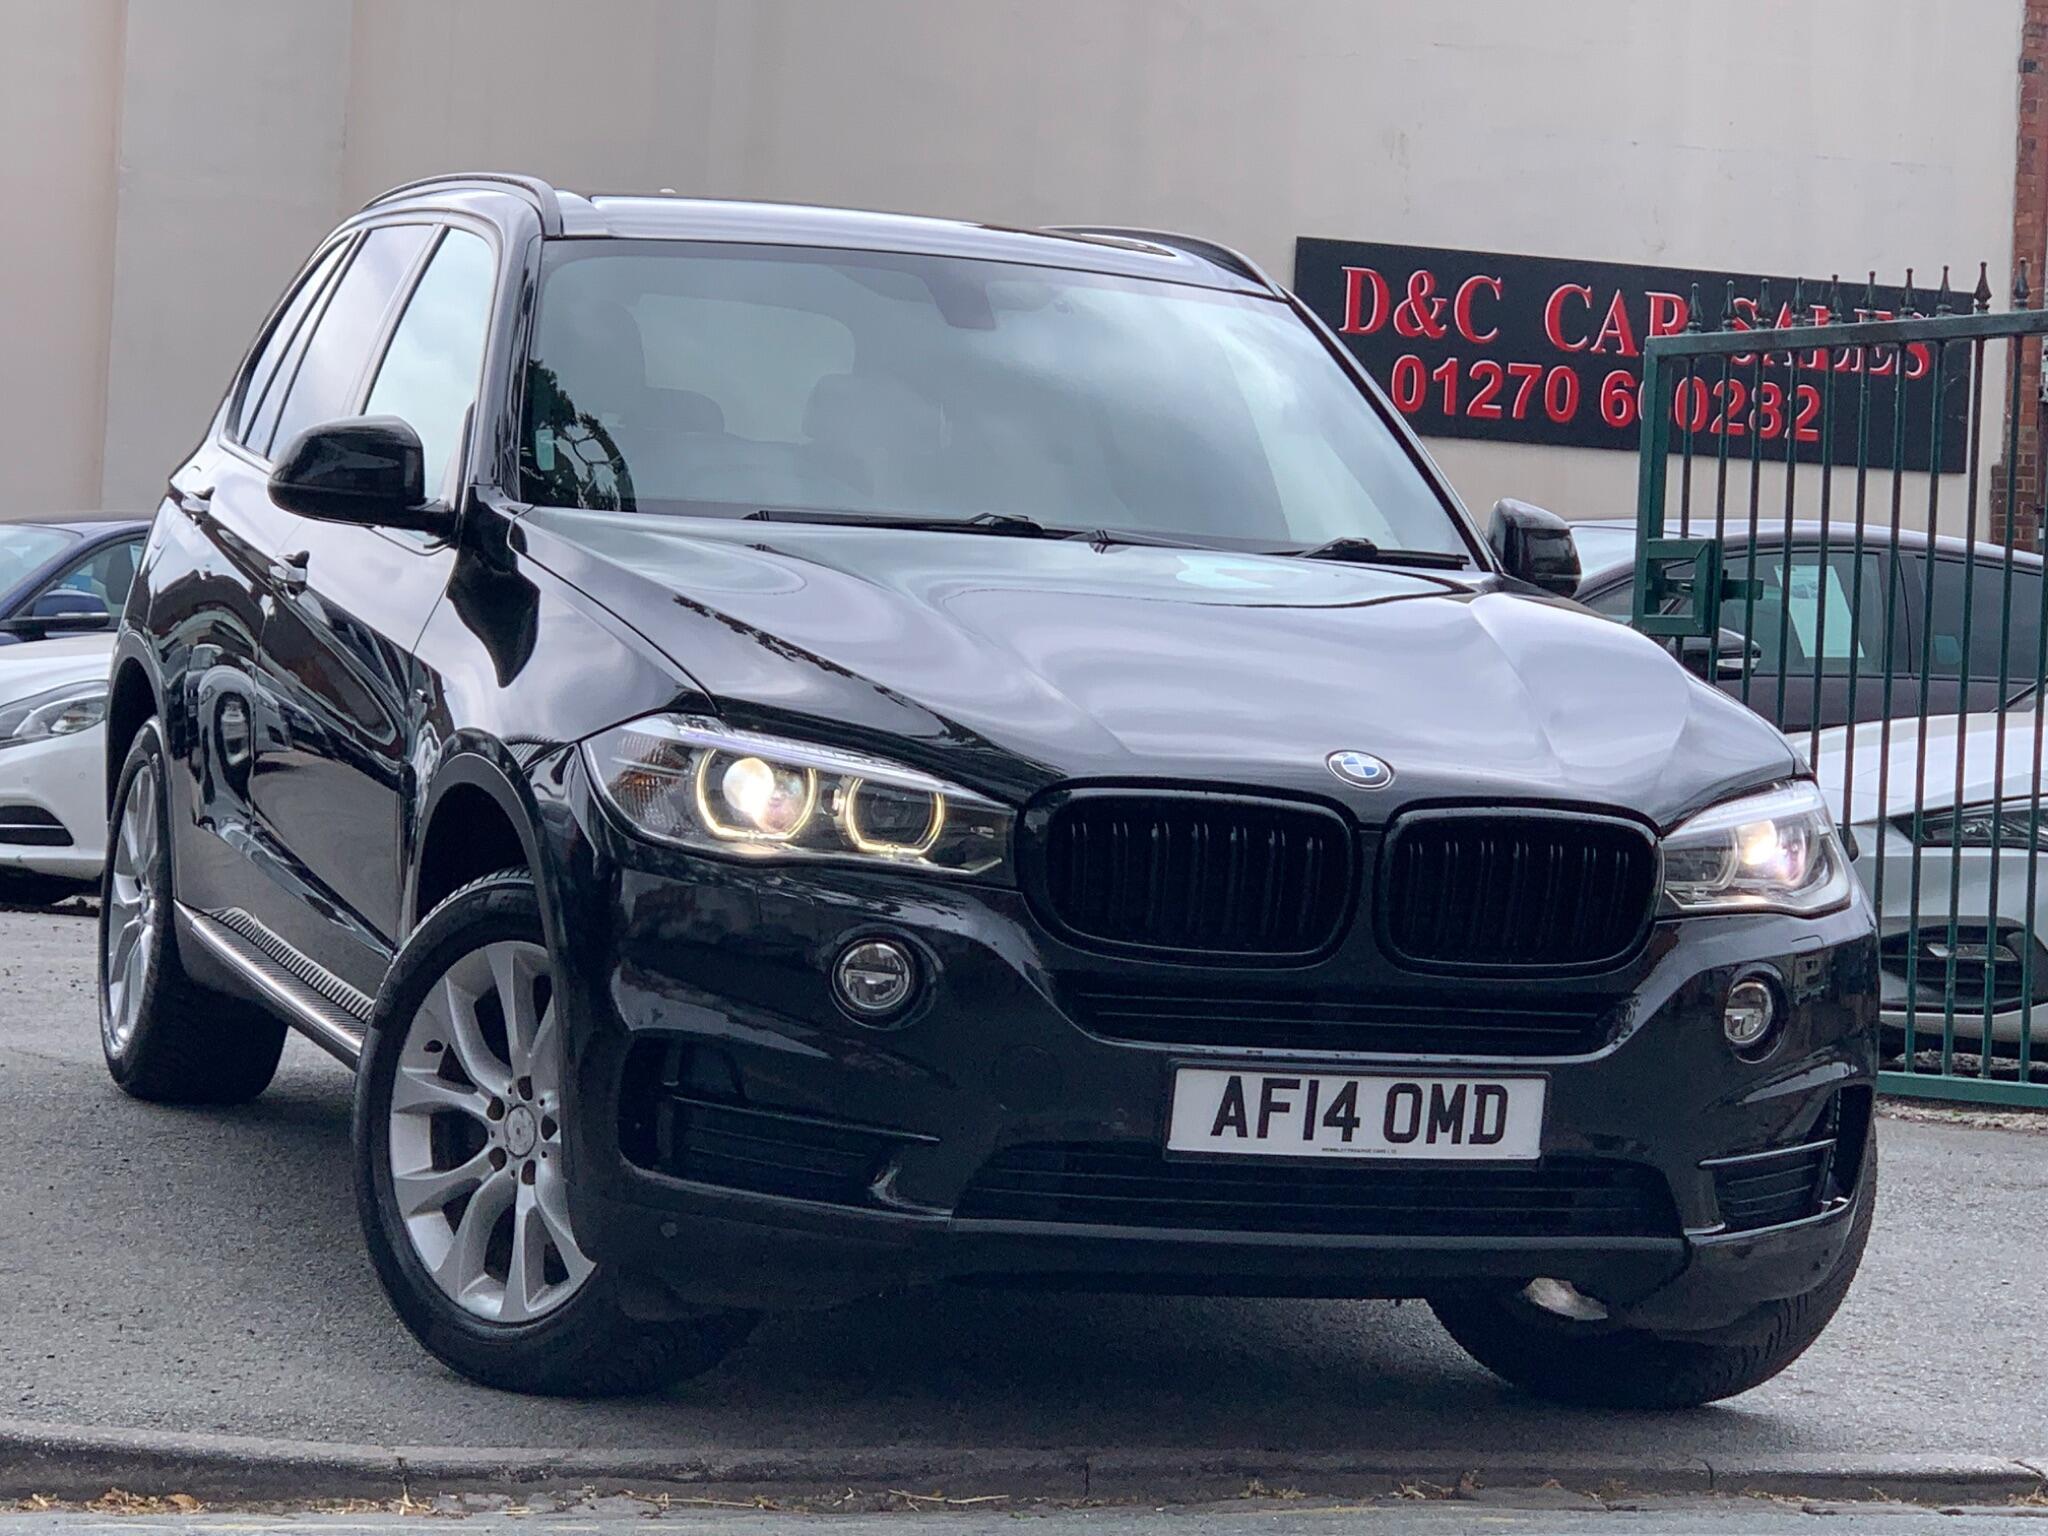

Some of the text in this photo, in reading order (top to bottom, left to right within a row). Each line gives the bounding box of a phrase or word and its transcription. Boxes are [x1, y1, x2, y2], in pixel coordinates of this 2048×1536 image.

[1339, 267, 1502, 344] D&C
[1391, 355, 1820, 441] 01270 60282
[1210, 1075, 1508, 1145] AF14 OMD
